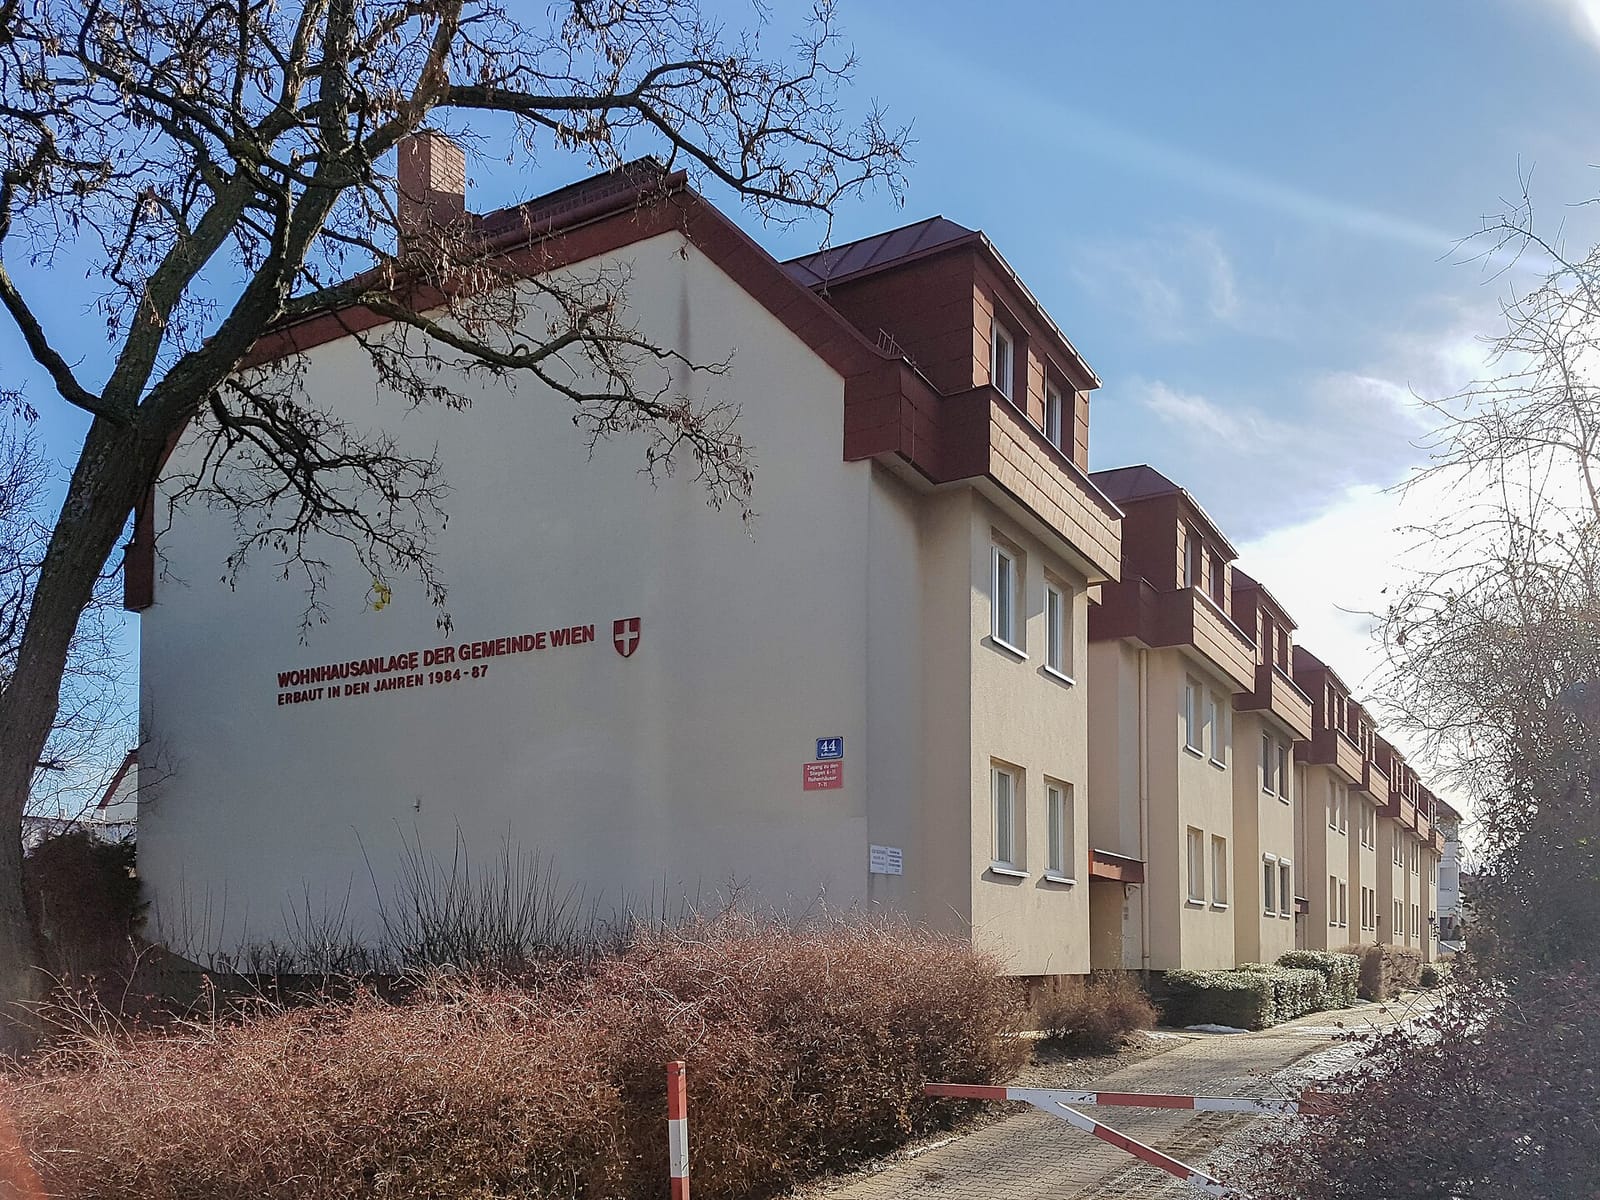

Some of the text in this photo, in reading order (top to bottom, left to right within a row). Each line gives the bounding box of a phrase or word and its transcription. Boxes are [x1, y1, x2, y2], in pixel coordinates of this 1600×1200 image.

[277, 624, 595, 688] WOHNHAUSANLAGE DER GEMEINDE WIEN
[277, 687, 324, 706] ERBAUT
[327, 685, 341, 699] IN
[344, 681, 370, 697] DEN
[373, 673, 424, 692] JAHREN
[820, 739, 837, 752] 44
